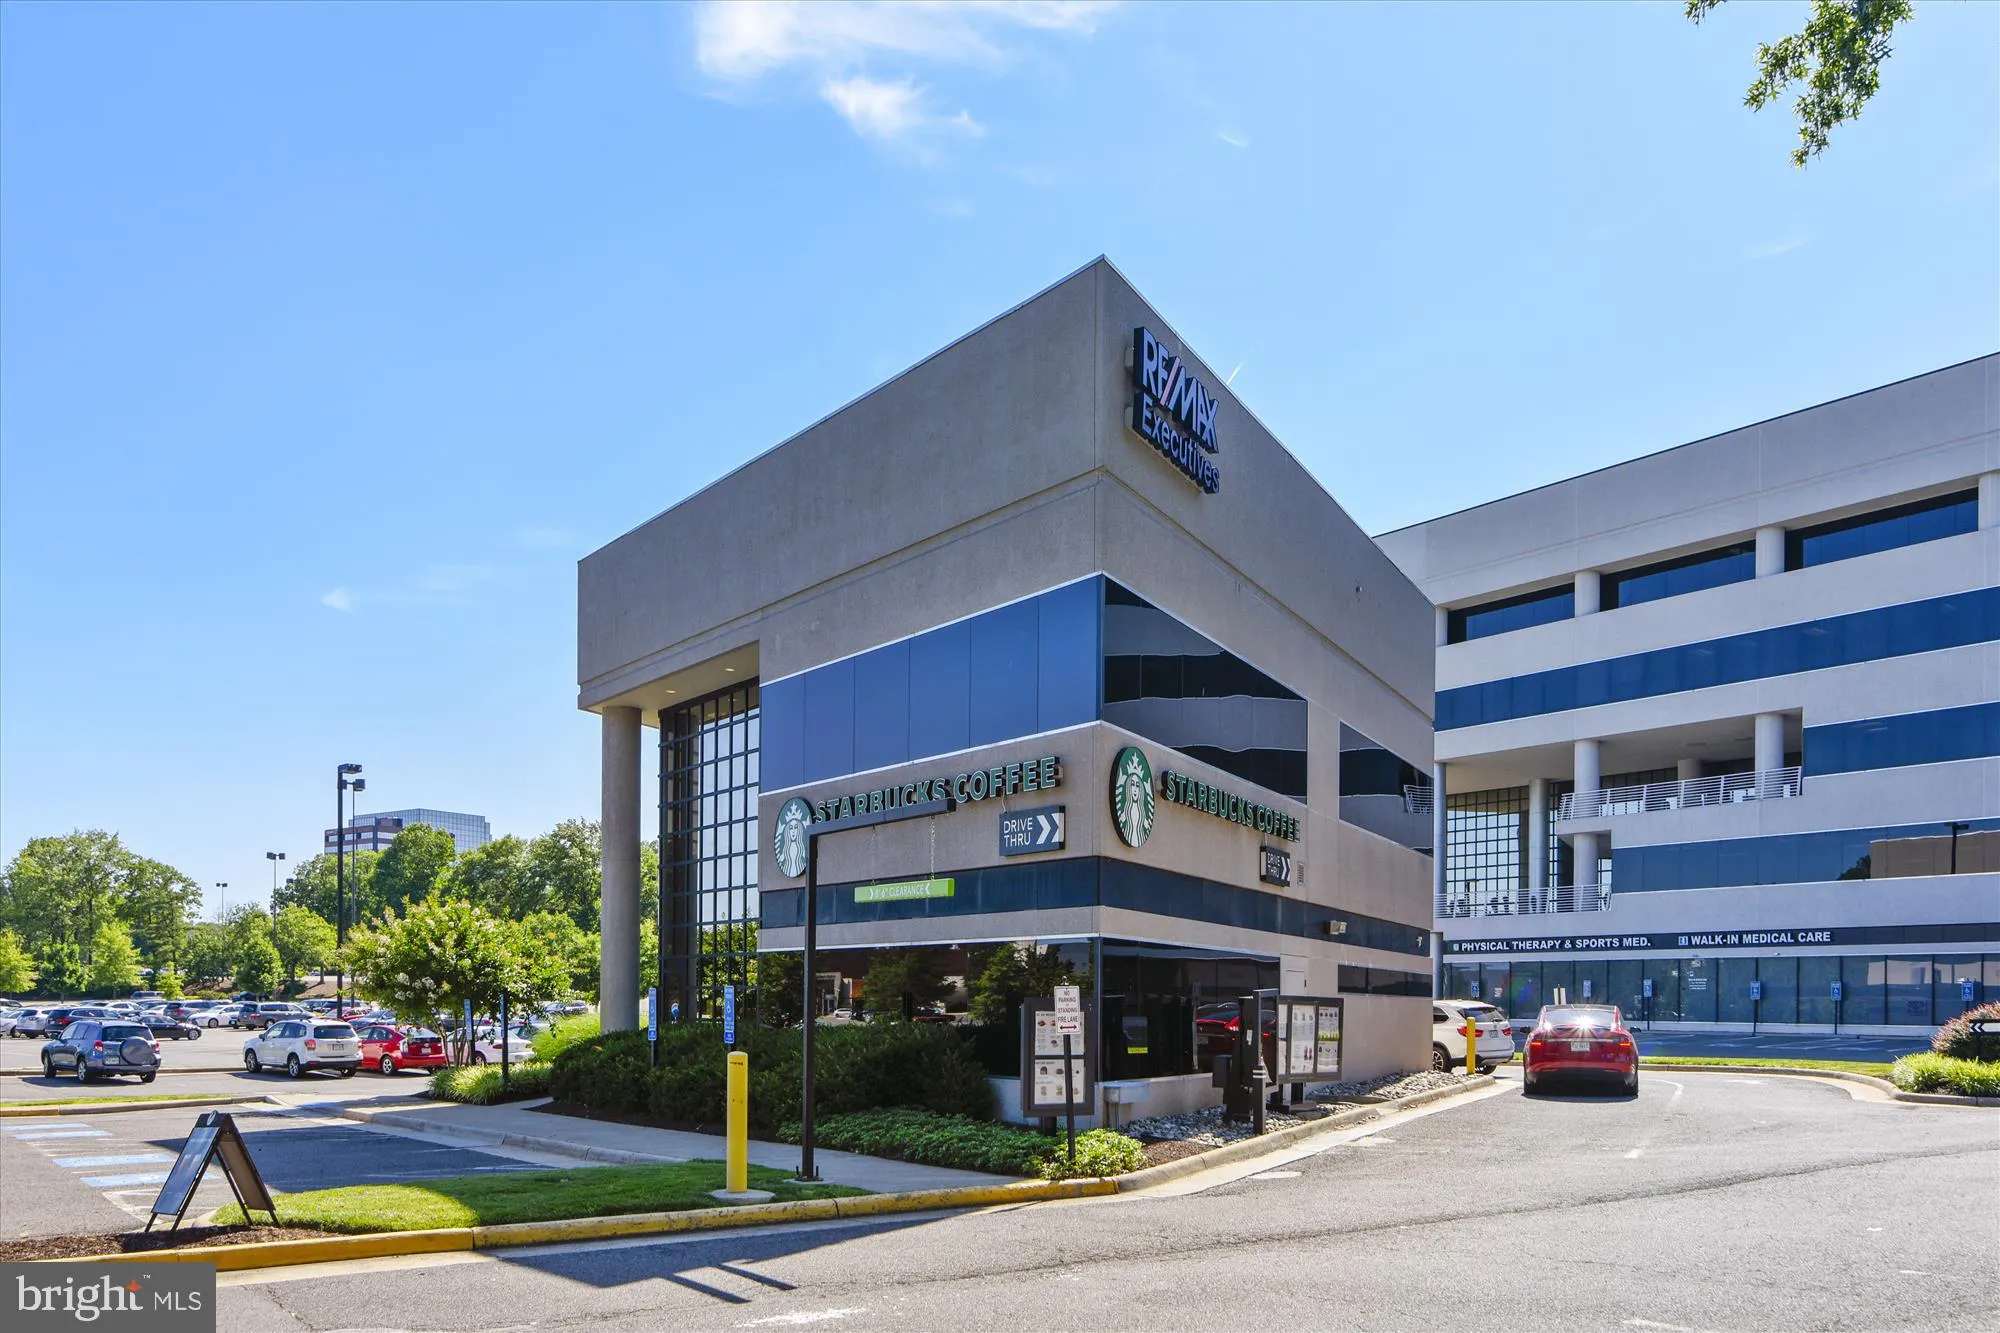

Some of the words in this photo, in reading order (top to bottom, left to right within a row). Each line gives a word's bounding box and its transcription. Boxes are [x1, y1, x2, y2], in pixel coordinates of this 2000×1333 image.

[1142, 327, 1219, 453] RE/MAX
[1142, 394, 1219, 493] Executives
[815, 778, 948, 822] STARBUCKS
[953, 756, 1059, 803] COFFEE
[1166, 770, 1253, 827] STARBUCKS
[1256, 803, 1301, 843] COFFEE
[1003, 817, 1033, 833] DRIVE
[1003, 832, 1031, 847] THRU
[889, 883, 925, 897] CLEARANCE
[1461, 942, 1509, 952] PHYSICAL
[1512, 939, 1561, 950] THERAPY
[1564, 939, 1572, 949] &
[1575, 938, 1620, 948] SPORTS
[1622, 936, 1652, 947] MED.
[1690, 934, 1739, 946] WALK-IN
[1742, 932, 1795, 944] MEDICAL
[1798, 931, 1831, 943] CARE
[1057, 1015, 1067, 1023] FIRE
